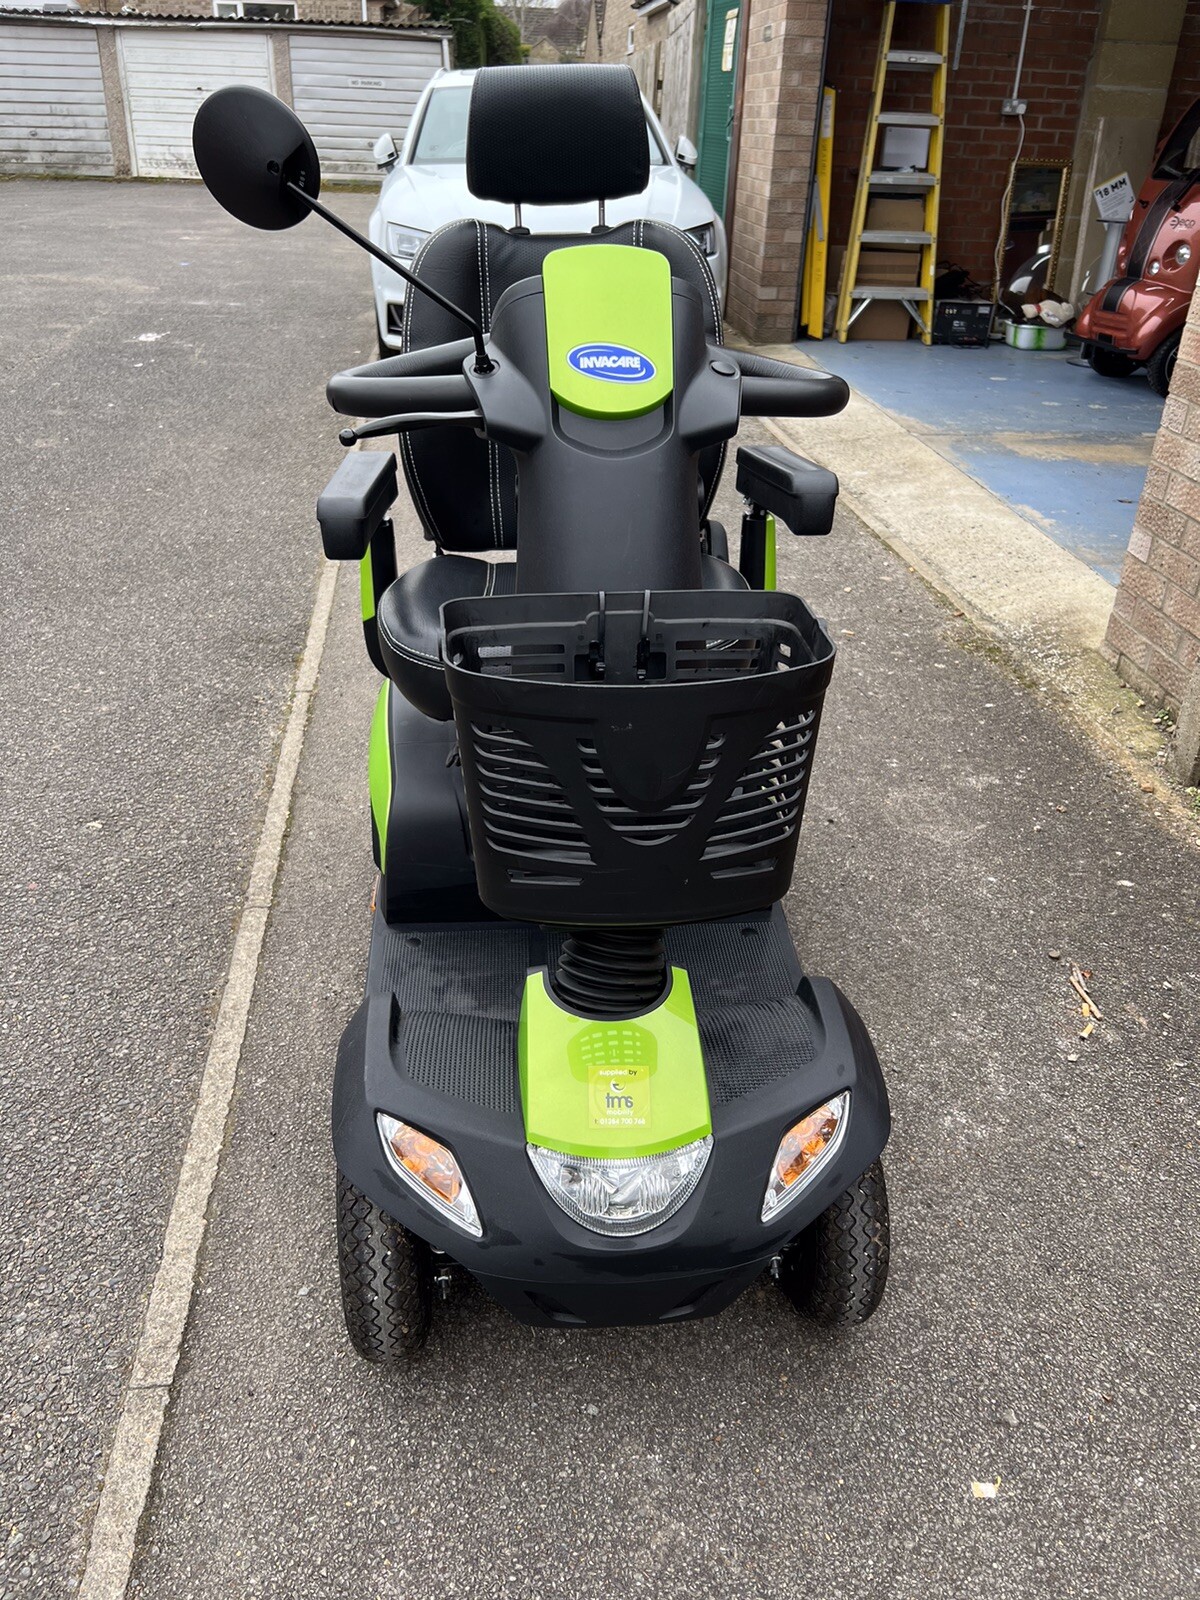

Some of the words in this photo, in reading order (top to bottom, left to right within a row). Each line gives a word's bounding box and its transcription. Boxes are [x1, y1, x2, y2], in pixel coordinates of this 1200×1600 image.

[1098, 187, 1110, 198] 18
[1110, 178, 1127, 192] MM
[579, 355, 640, 369] INVACARE
[605, 1092, 634, 1108] tms
